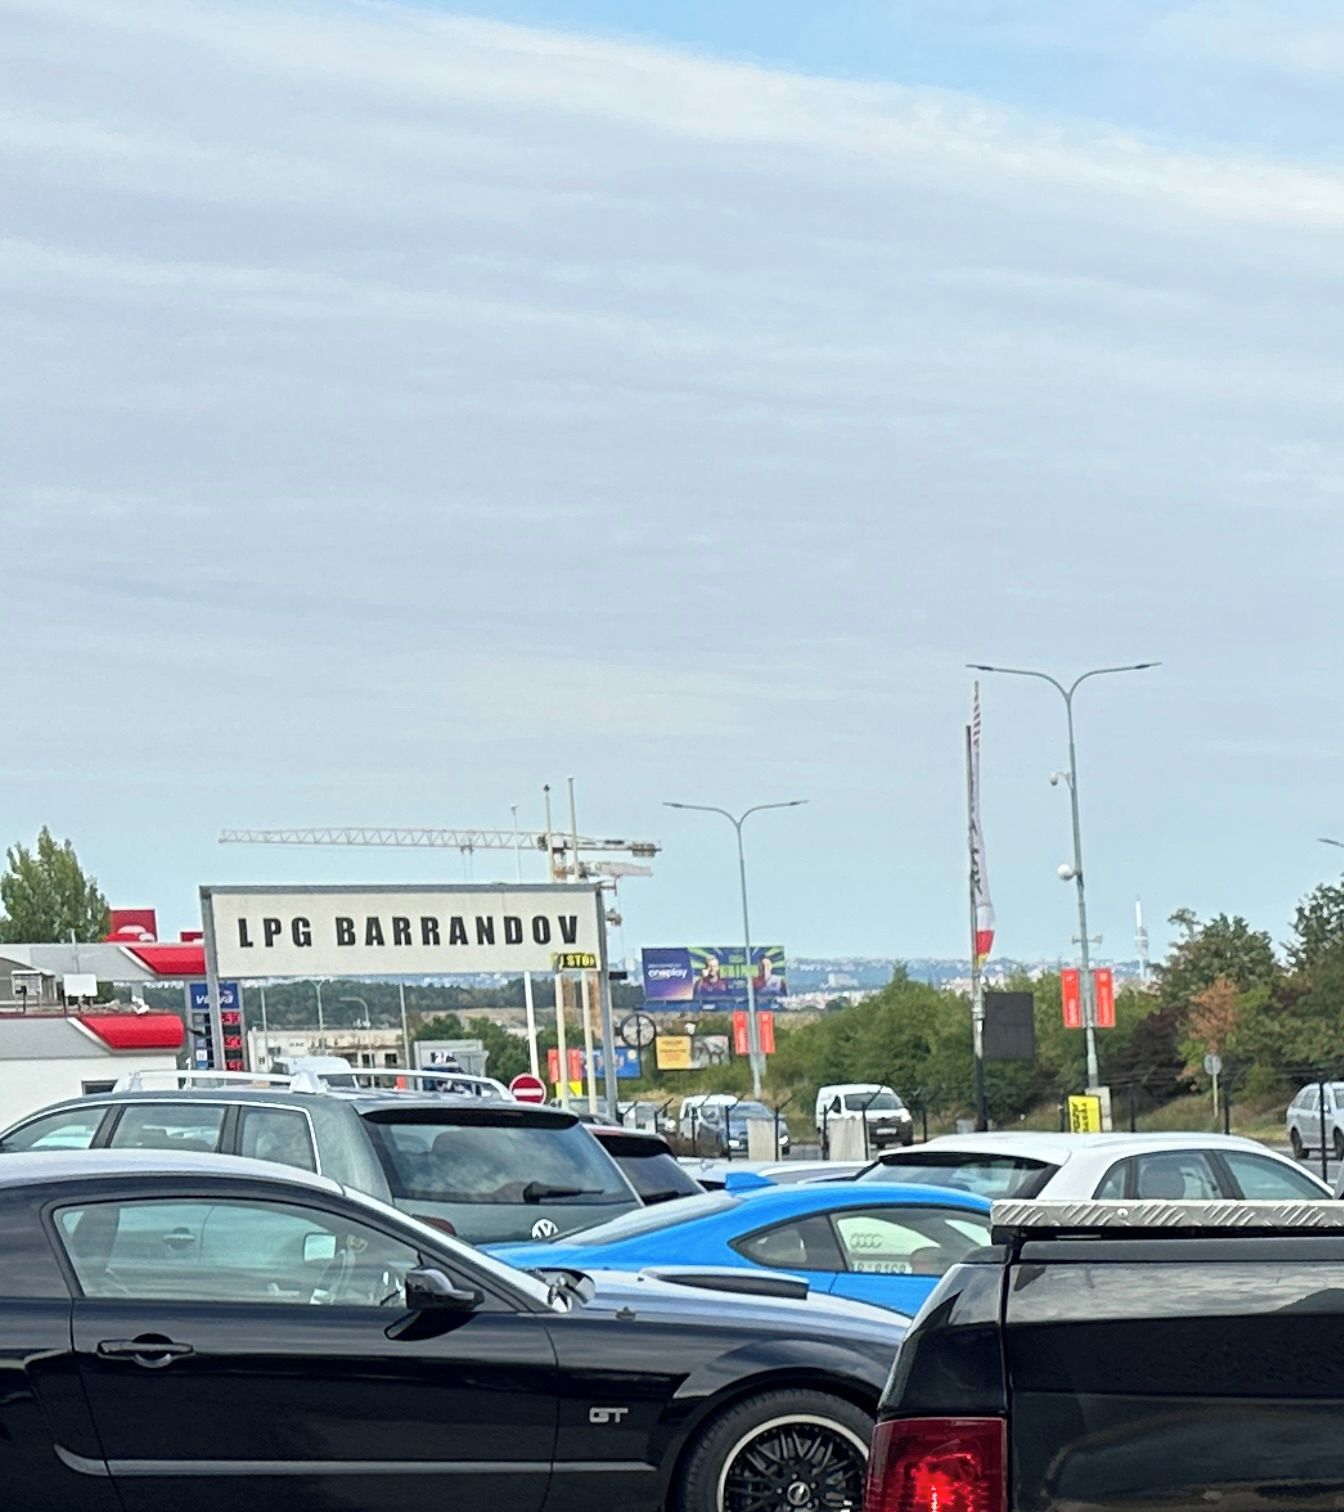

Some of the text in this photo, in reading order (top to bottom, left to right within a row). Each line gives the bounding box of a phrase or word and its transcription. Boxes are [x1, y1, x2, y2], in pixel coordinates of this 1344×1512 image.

[238, 916, 578, 948] LPG BARRANDOV
[589, 1407, 629, 1423] GT
